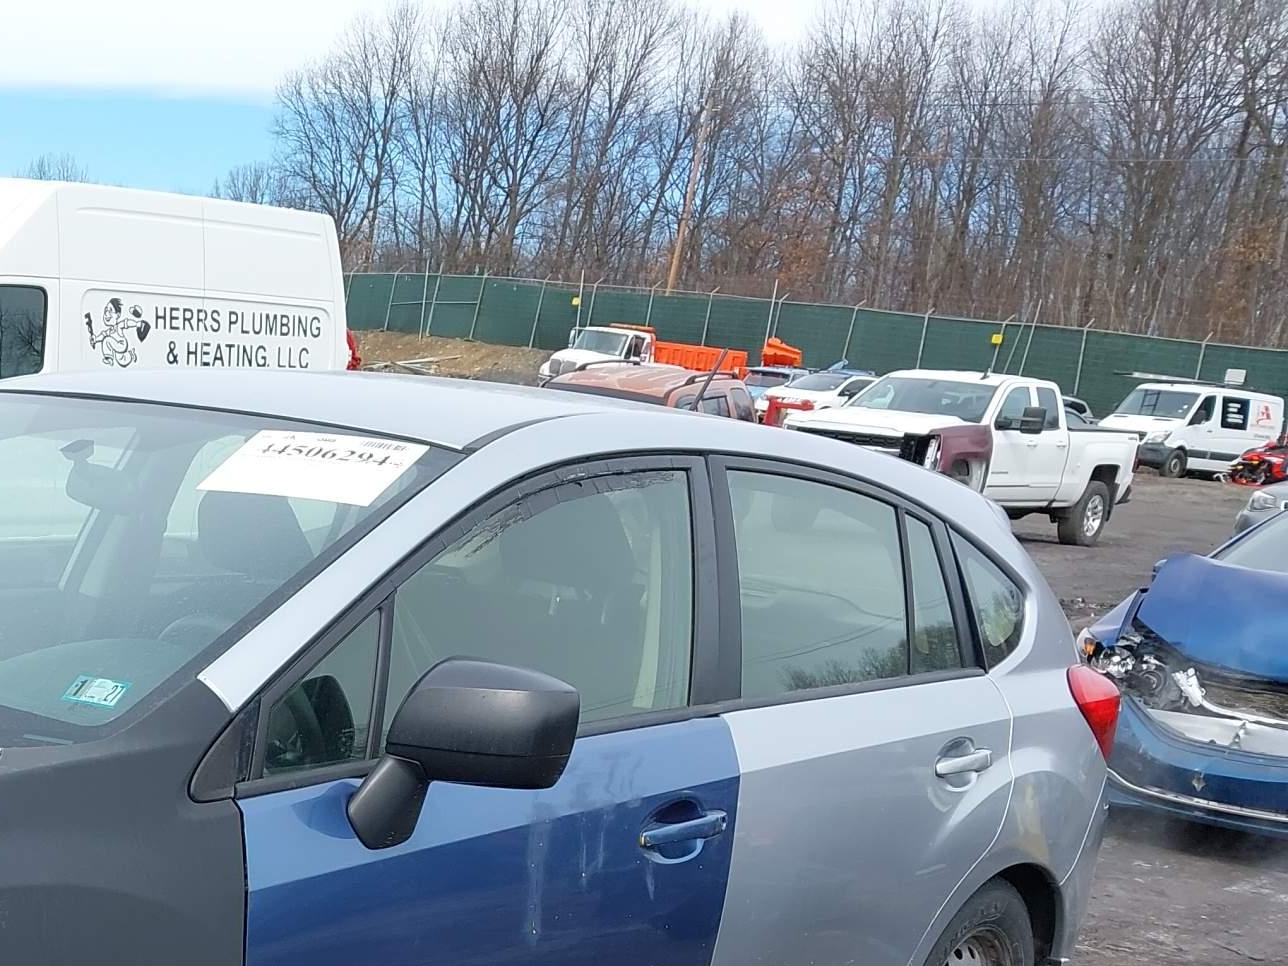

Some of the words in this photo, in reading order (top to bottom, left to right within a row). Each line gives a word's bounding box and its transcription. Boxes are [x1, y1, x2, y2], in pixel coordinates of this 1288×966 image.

[154, 306, 221, 333] HERRS
[227, 310, 322, 338] PLUMBING
[166, 340, 179, 365] &
[277, 347, 310, 369] LLC
